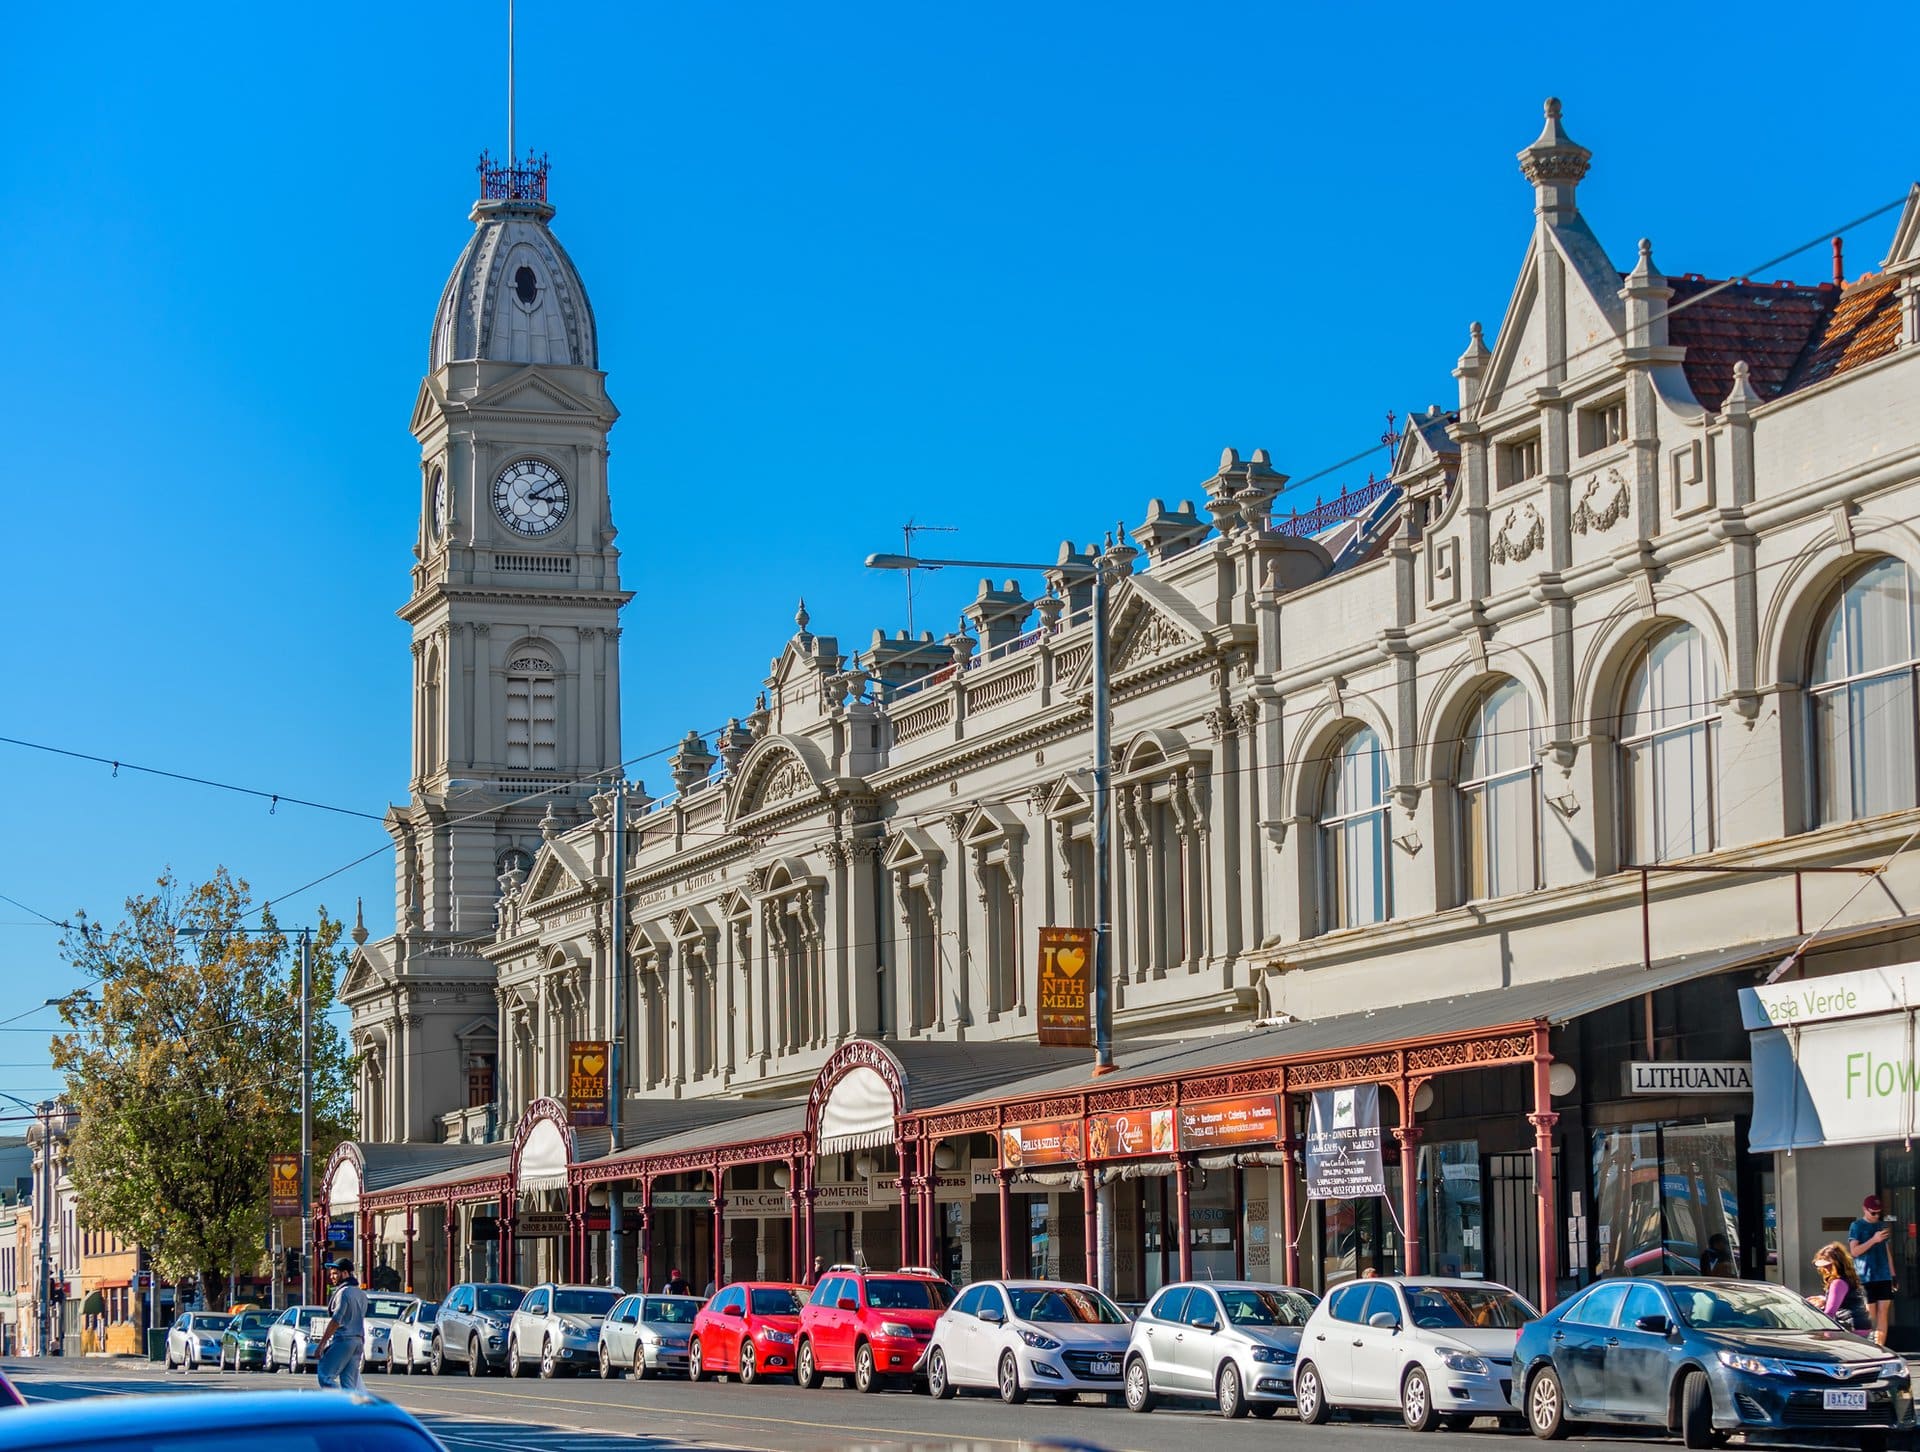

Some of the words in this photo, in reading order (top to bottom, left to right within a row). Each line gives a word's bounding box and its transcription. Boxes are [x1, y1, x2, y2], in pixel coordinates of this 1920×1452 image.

[1042, 947, 1057, 978] I
[1042, 979, 1085, 995] NTH
[1042, 995, 1085, 1009] MELB
[1757, 999, 1799, 1022] Casa
[1803, 987, 1857, 1016] Verde
[571, 1054, 582, 1077] I
[571, 1077, 604, 1088] NTH
[571, 1088, 604, 1098] MELB
[1332, 1128, 1358, 1139] DINNER
[1022, 1139, 1037, 1151] GRILLS
[273, 1180, 298, 1190] NTH
[272, 1189, 298, 1197] MELB
[733, 1196, 755, 1206] The
[522, 1223, 540, 1232] SHOE
[548, 1222, 563, 1232] BAG
